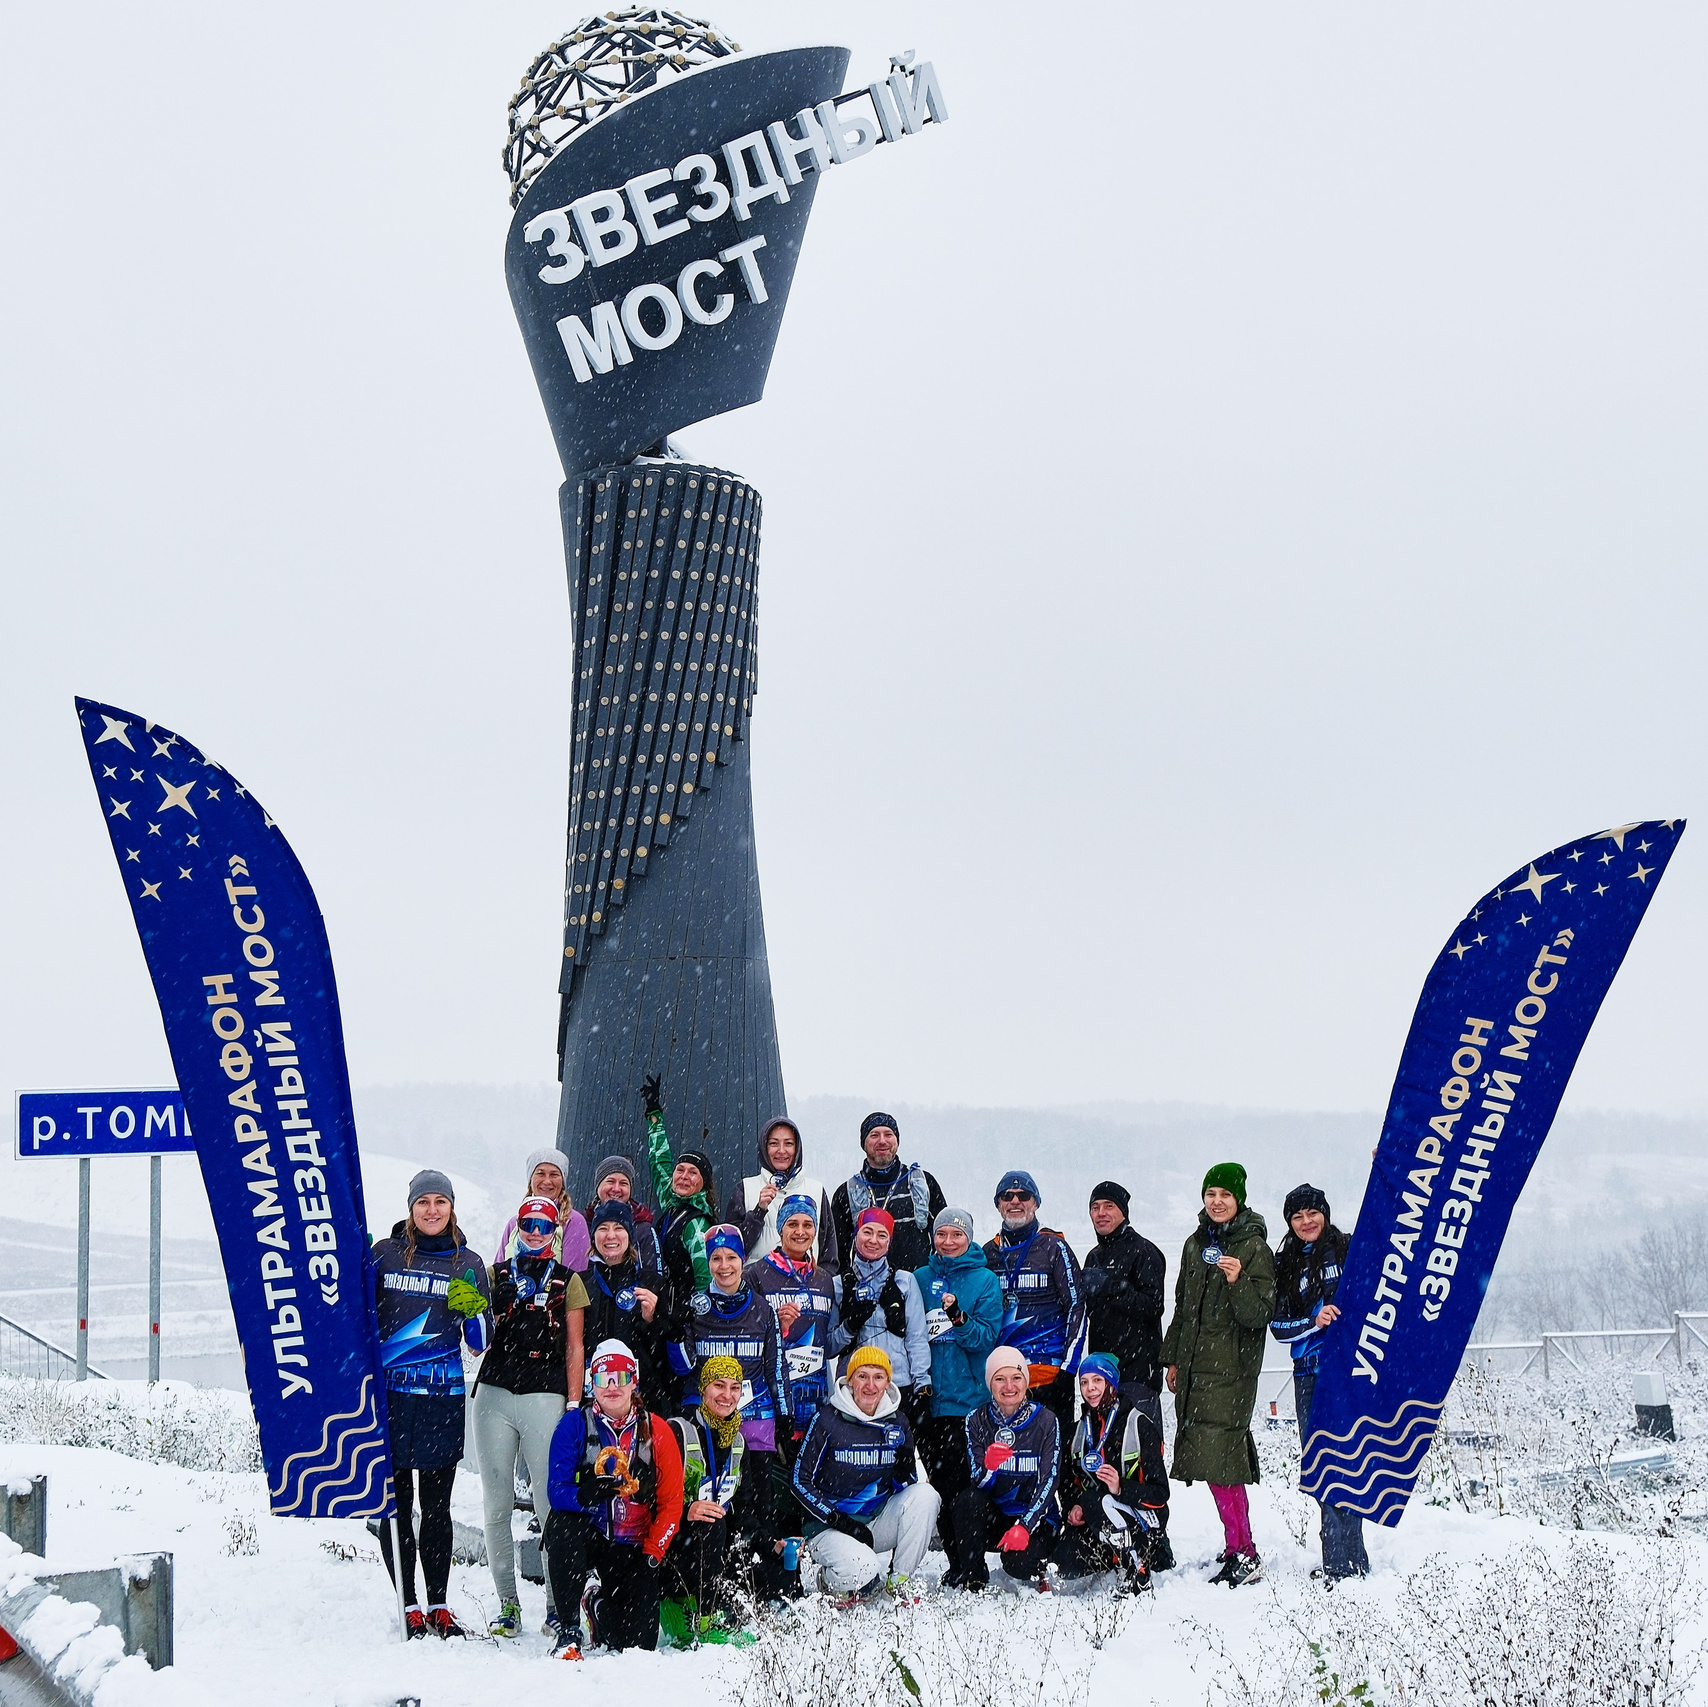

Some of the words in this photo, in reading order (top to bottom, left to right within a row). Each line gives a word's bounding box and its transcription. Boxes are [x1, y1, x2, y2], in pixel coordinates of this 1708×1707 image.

[524, 49, 949, 285] ЗВЕЗДНЫЙ
[556, 235, 770, 383] МОСТ
[224, 854, 286, 1006] МОСТ»
[202, 973, 313, 1400] УЛЬТРАМАРАФОН
[253, 1021, 340, 1306] «ЗВЕЗДНЫЙ
[1351, 1016, 1494, 1385] УЛЬТРАМАРАФОН
[1419, 1069, 1522, 1322] «ЗВЕЗДНЫЙ
[1499, 927, 1575, 1061] МОСТ»
[798, 1362, 811, 1374] 34
[928, 1324, 941, 1336] 42
